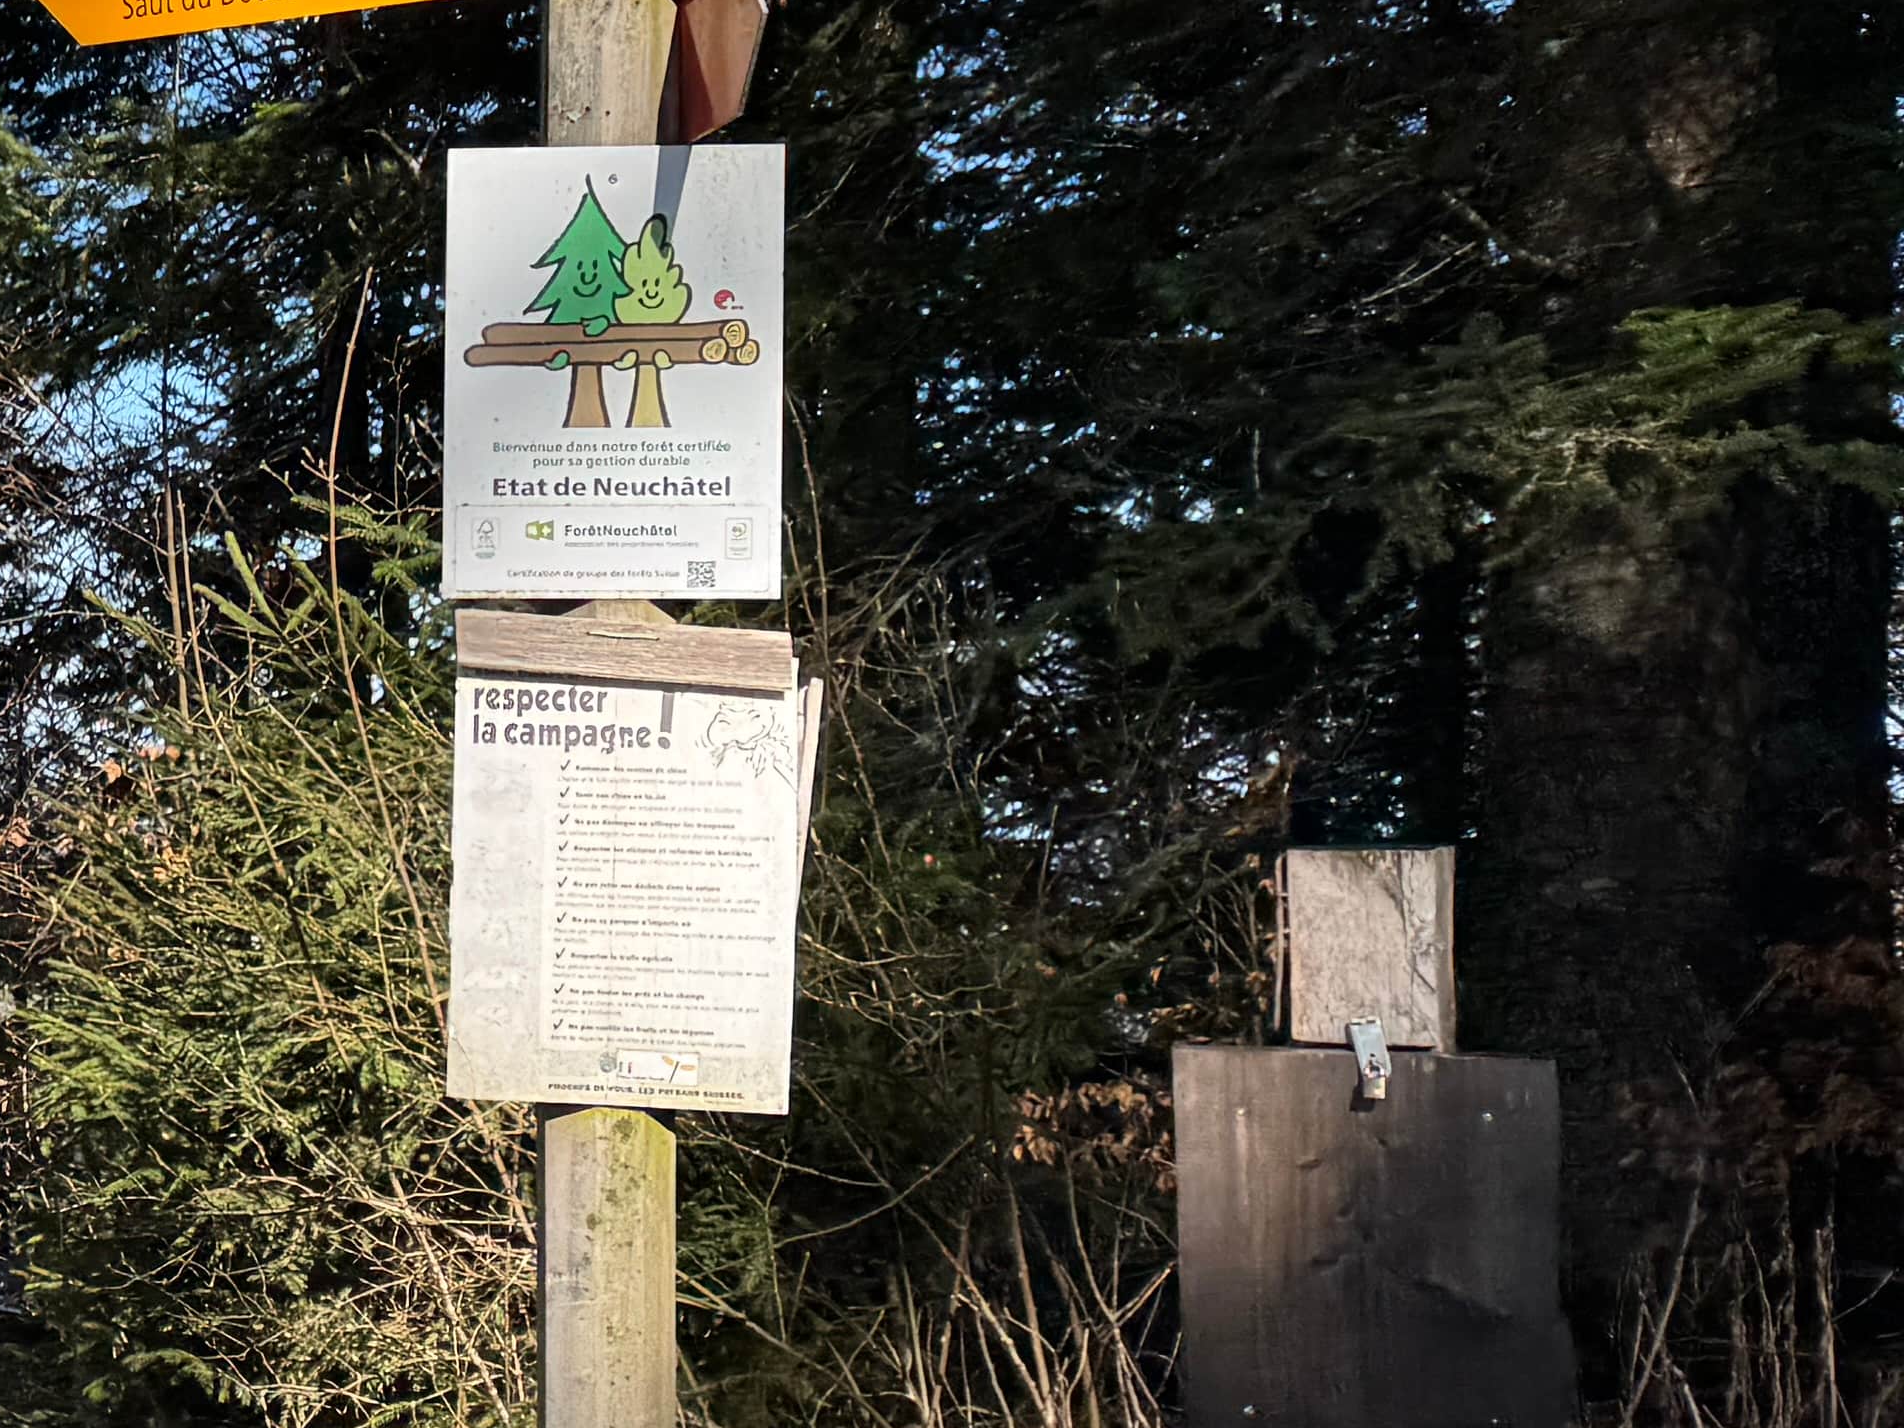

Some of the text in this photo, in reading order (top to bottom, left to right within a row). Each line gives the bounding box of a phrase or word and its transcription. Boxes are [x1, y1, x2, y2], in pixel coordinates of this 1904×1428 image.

[493, 441, 562, 453] Bienvenue
[567, 441, 597, 453] dans
[602, 443, 638, 453] notre
[533, 455, 690, 468] pour sa gestion durable
[493, 476, 731, 496] Etat de Neuchâtel
[474, 686, 608, 717] respecter
[473, 714, 496, 744] la
